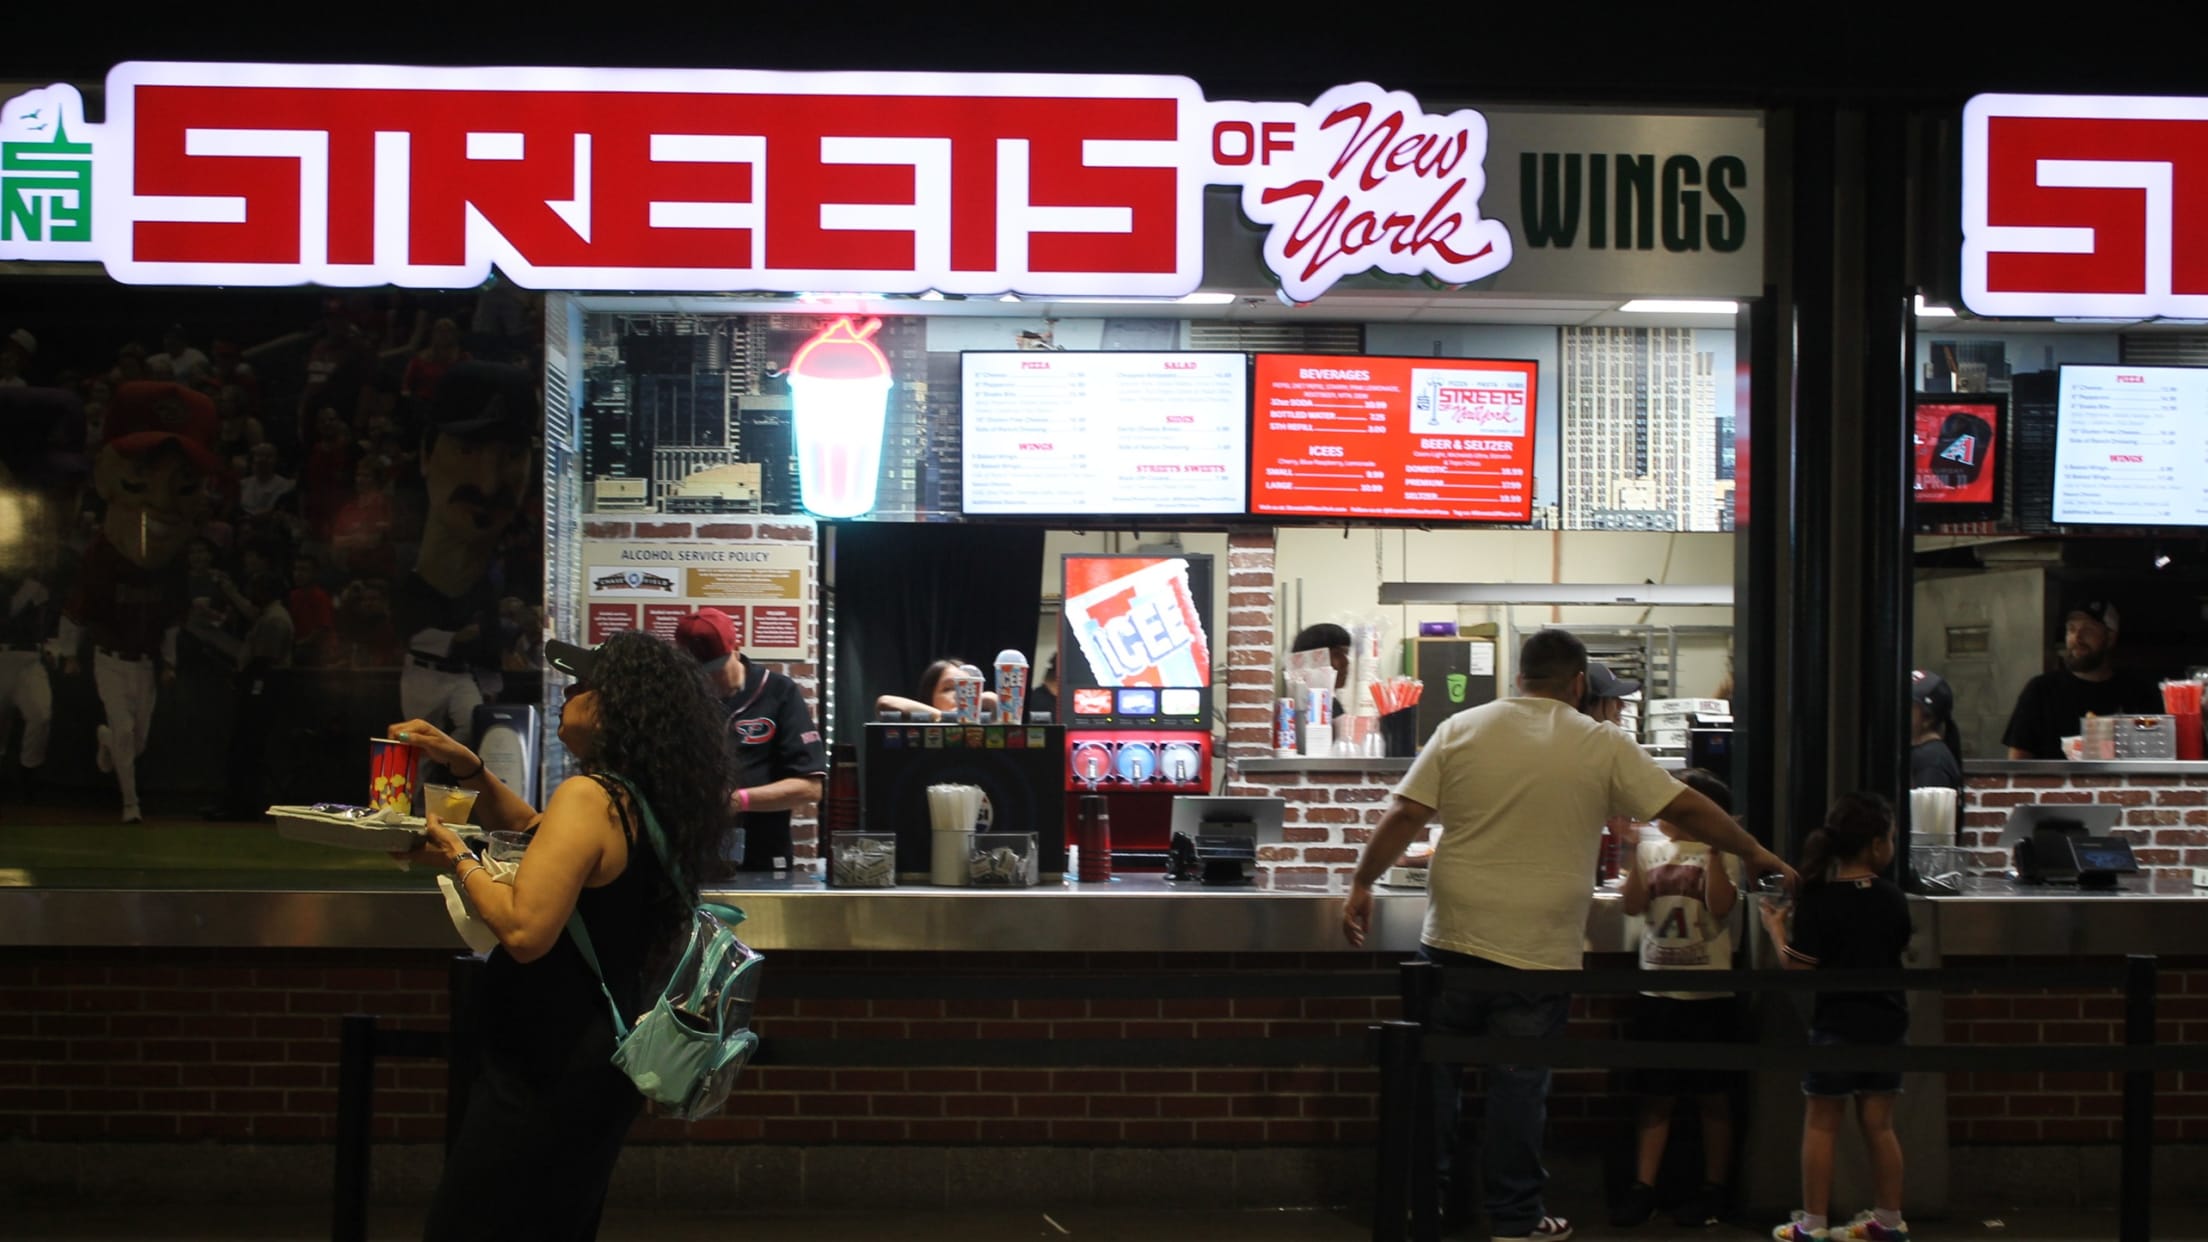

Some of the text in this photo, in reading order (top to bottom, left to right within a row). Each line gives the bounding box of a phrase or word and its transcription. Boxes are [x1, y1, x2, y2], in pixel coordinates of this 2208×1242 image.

[1320, 102, 1468, 192] New
[132, 84, 1296, 274] STREETS OF
[1519, 152, 1748, 253] WINGS
[1261, 177, 1493, 282] York
[1021, 361, 1050, 370] PIZZA
[1164, 361, 1198, 370] SALAD
[1299, 367, 1370, 381] BEVERAGES
[2116, 374, 2145, 384] PIZZA
[1439, 387, 1524, 406] STREETS
[1166, 415, 1194, 424] SIDES
[1269, 410, 1307, 419] BOTTLED
[1307, 411, 1337, 421] WATER
[1018, 442, 1054, 452] WINGS
[1420, 437, 1514, 452] BEER & SELTZER
[1308, 444, 1345, 458] ICEES
[2109, 454, 2145, 464] WINGS
[1136, 464, 1226, 474] STREETS SWEETS
[1265, 468, 1293, 477] SMALL
[1404, 464, 1449, 474] DOMESTIC
[1265, 481, 1294, 491] LARGE
[1404, 478, 1445, 488] PREMIUM
[1403, 491, 1439, 501] SELTZER
[620, 549, 770, 563] ALCOHOL SERVICE POLICY
[1091, 590, 1193, 678] ICEE
